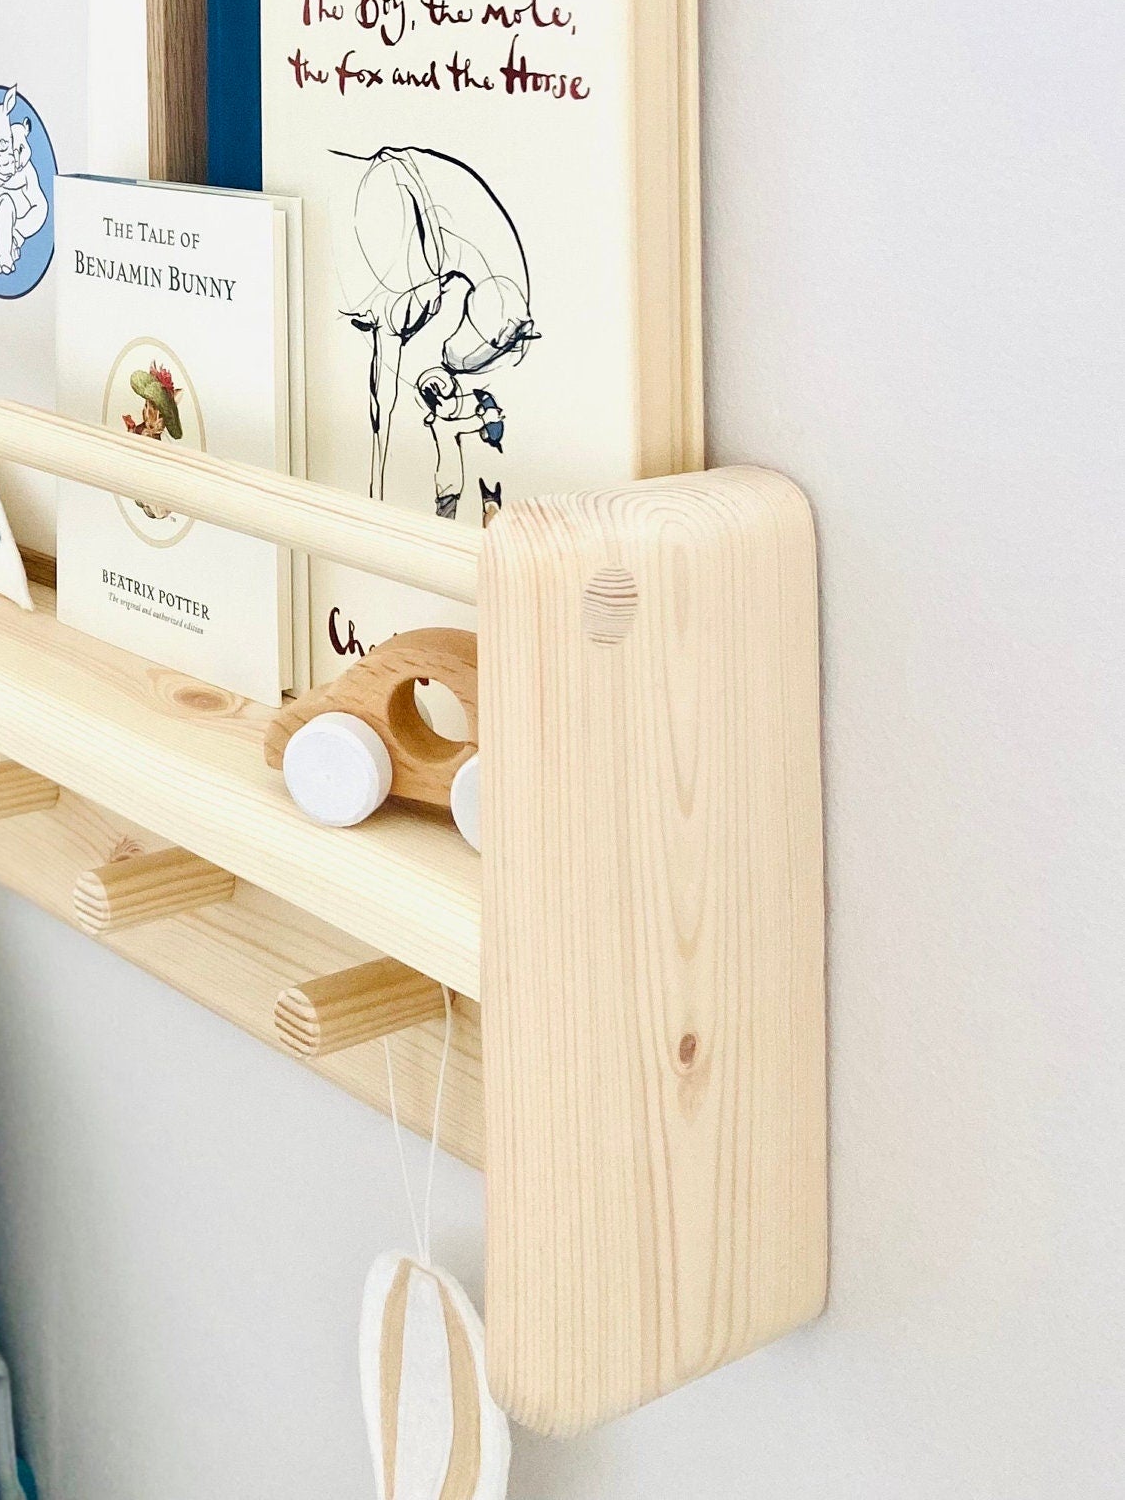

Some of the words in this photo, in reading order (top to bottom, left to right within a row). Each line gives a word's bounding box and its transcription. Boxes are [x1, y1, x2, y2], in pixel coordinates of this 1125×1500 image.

[287, 48, 329, 88] the
[335, 50, 383, 96] fox
[392, 60, 440, 90] and
[446, 50, 494, 91] the
[499, 34, 590, 100] Horse
[102, 568, 155, 601] BEATRIX
[158, 589, 210, 620] POTTER
